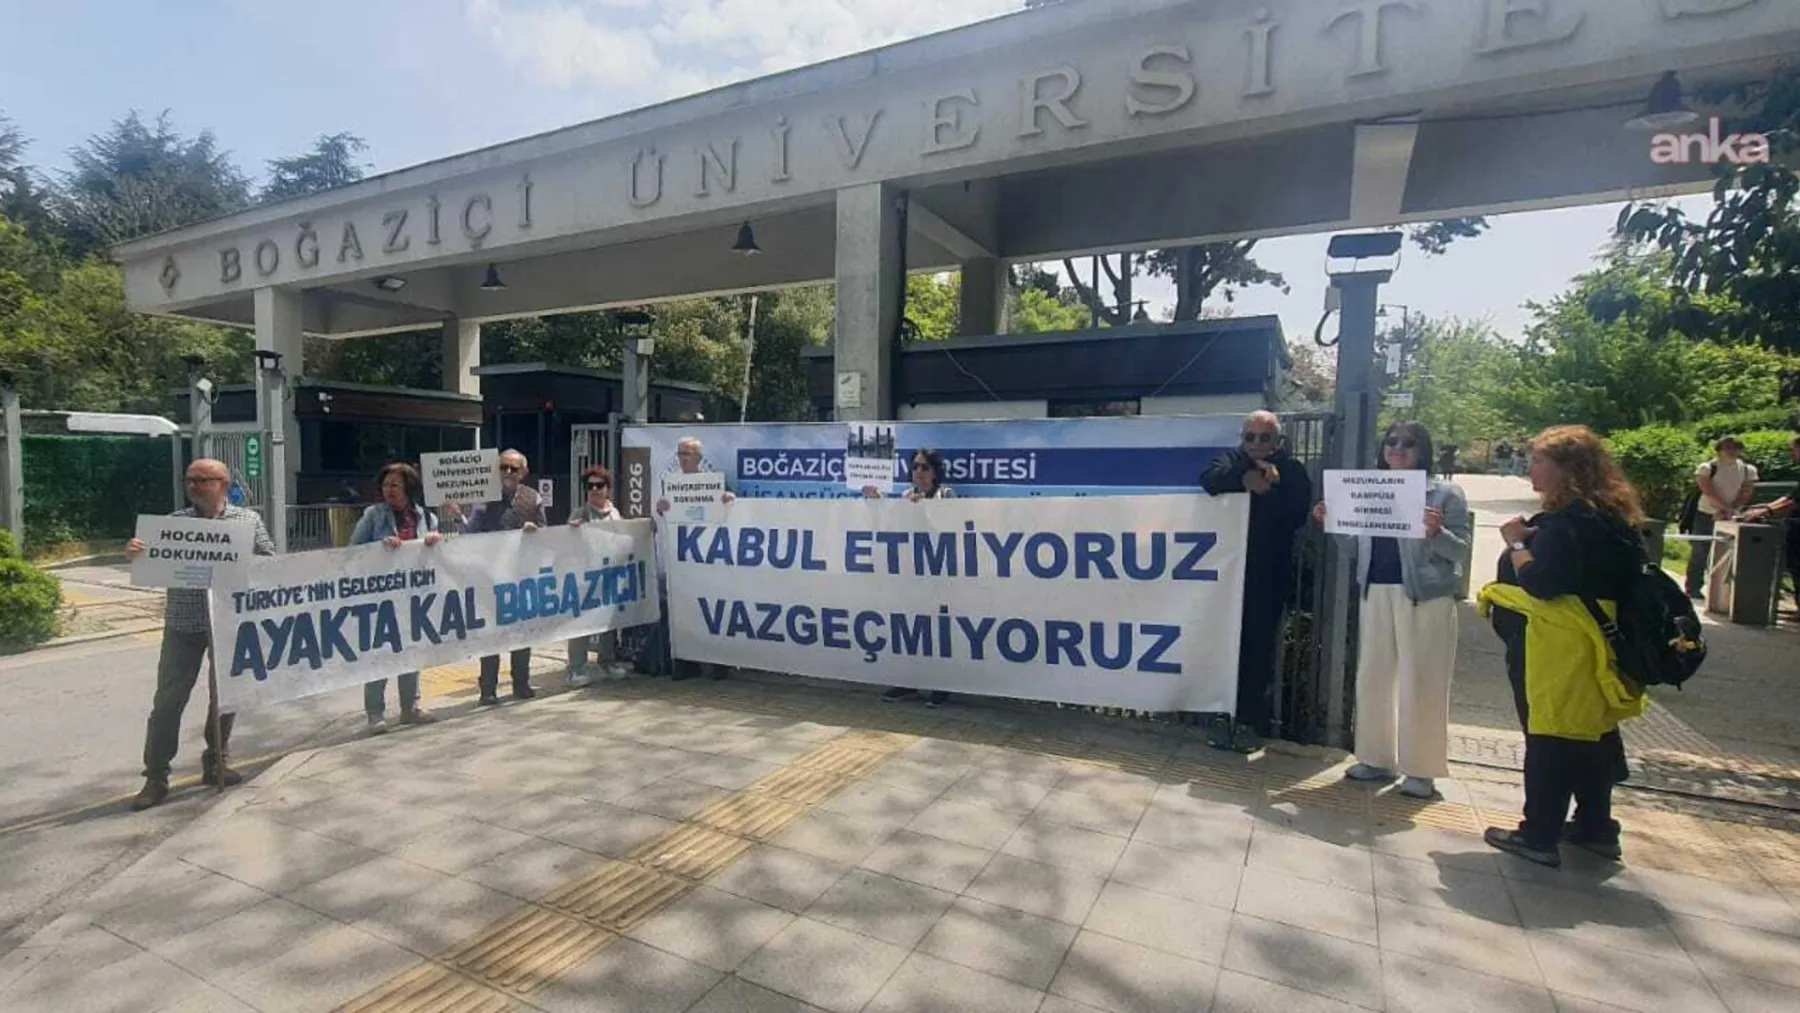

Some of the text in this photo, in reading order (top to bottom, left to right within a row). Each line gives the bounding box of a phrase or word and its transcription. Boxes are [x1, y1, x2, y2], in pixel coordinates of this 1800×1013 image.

[218, 0, 1757, 284] BOĞAZİÇİ ÜNİVERSİTE
[436, 478, 489, 489] MEZUNLARI
[743, 452, 848, 483] BOĞAZİÇİ
[1342, 475, 1405, 485] MEZUNLARIN
[629, 462, 643, 516] 2026
[1351, 490, 1395, 500] KAMPÜSE
[149, 547, 239, 562] DOKUNMA!
[160, 529, 231, 545] HOCAMA
[676, 520, 1218, 582] KABUL ETMİYORUZ
[232, 580, 335, 614] TÜRKİYE'NİN
[410, 566, 436, 587] İÇİN
[230, 553, 647, 681] AYAKTA KAL BOĞAZİÇİ!
[697, 596, 1182, 675] VAZGEÇMİYORUZ
